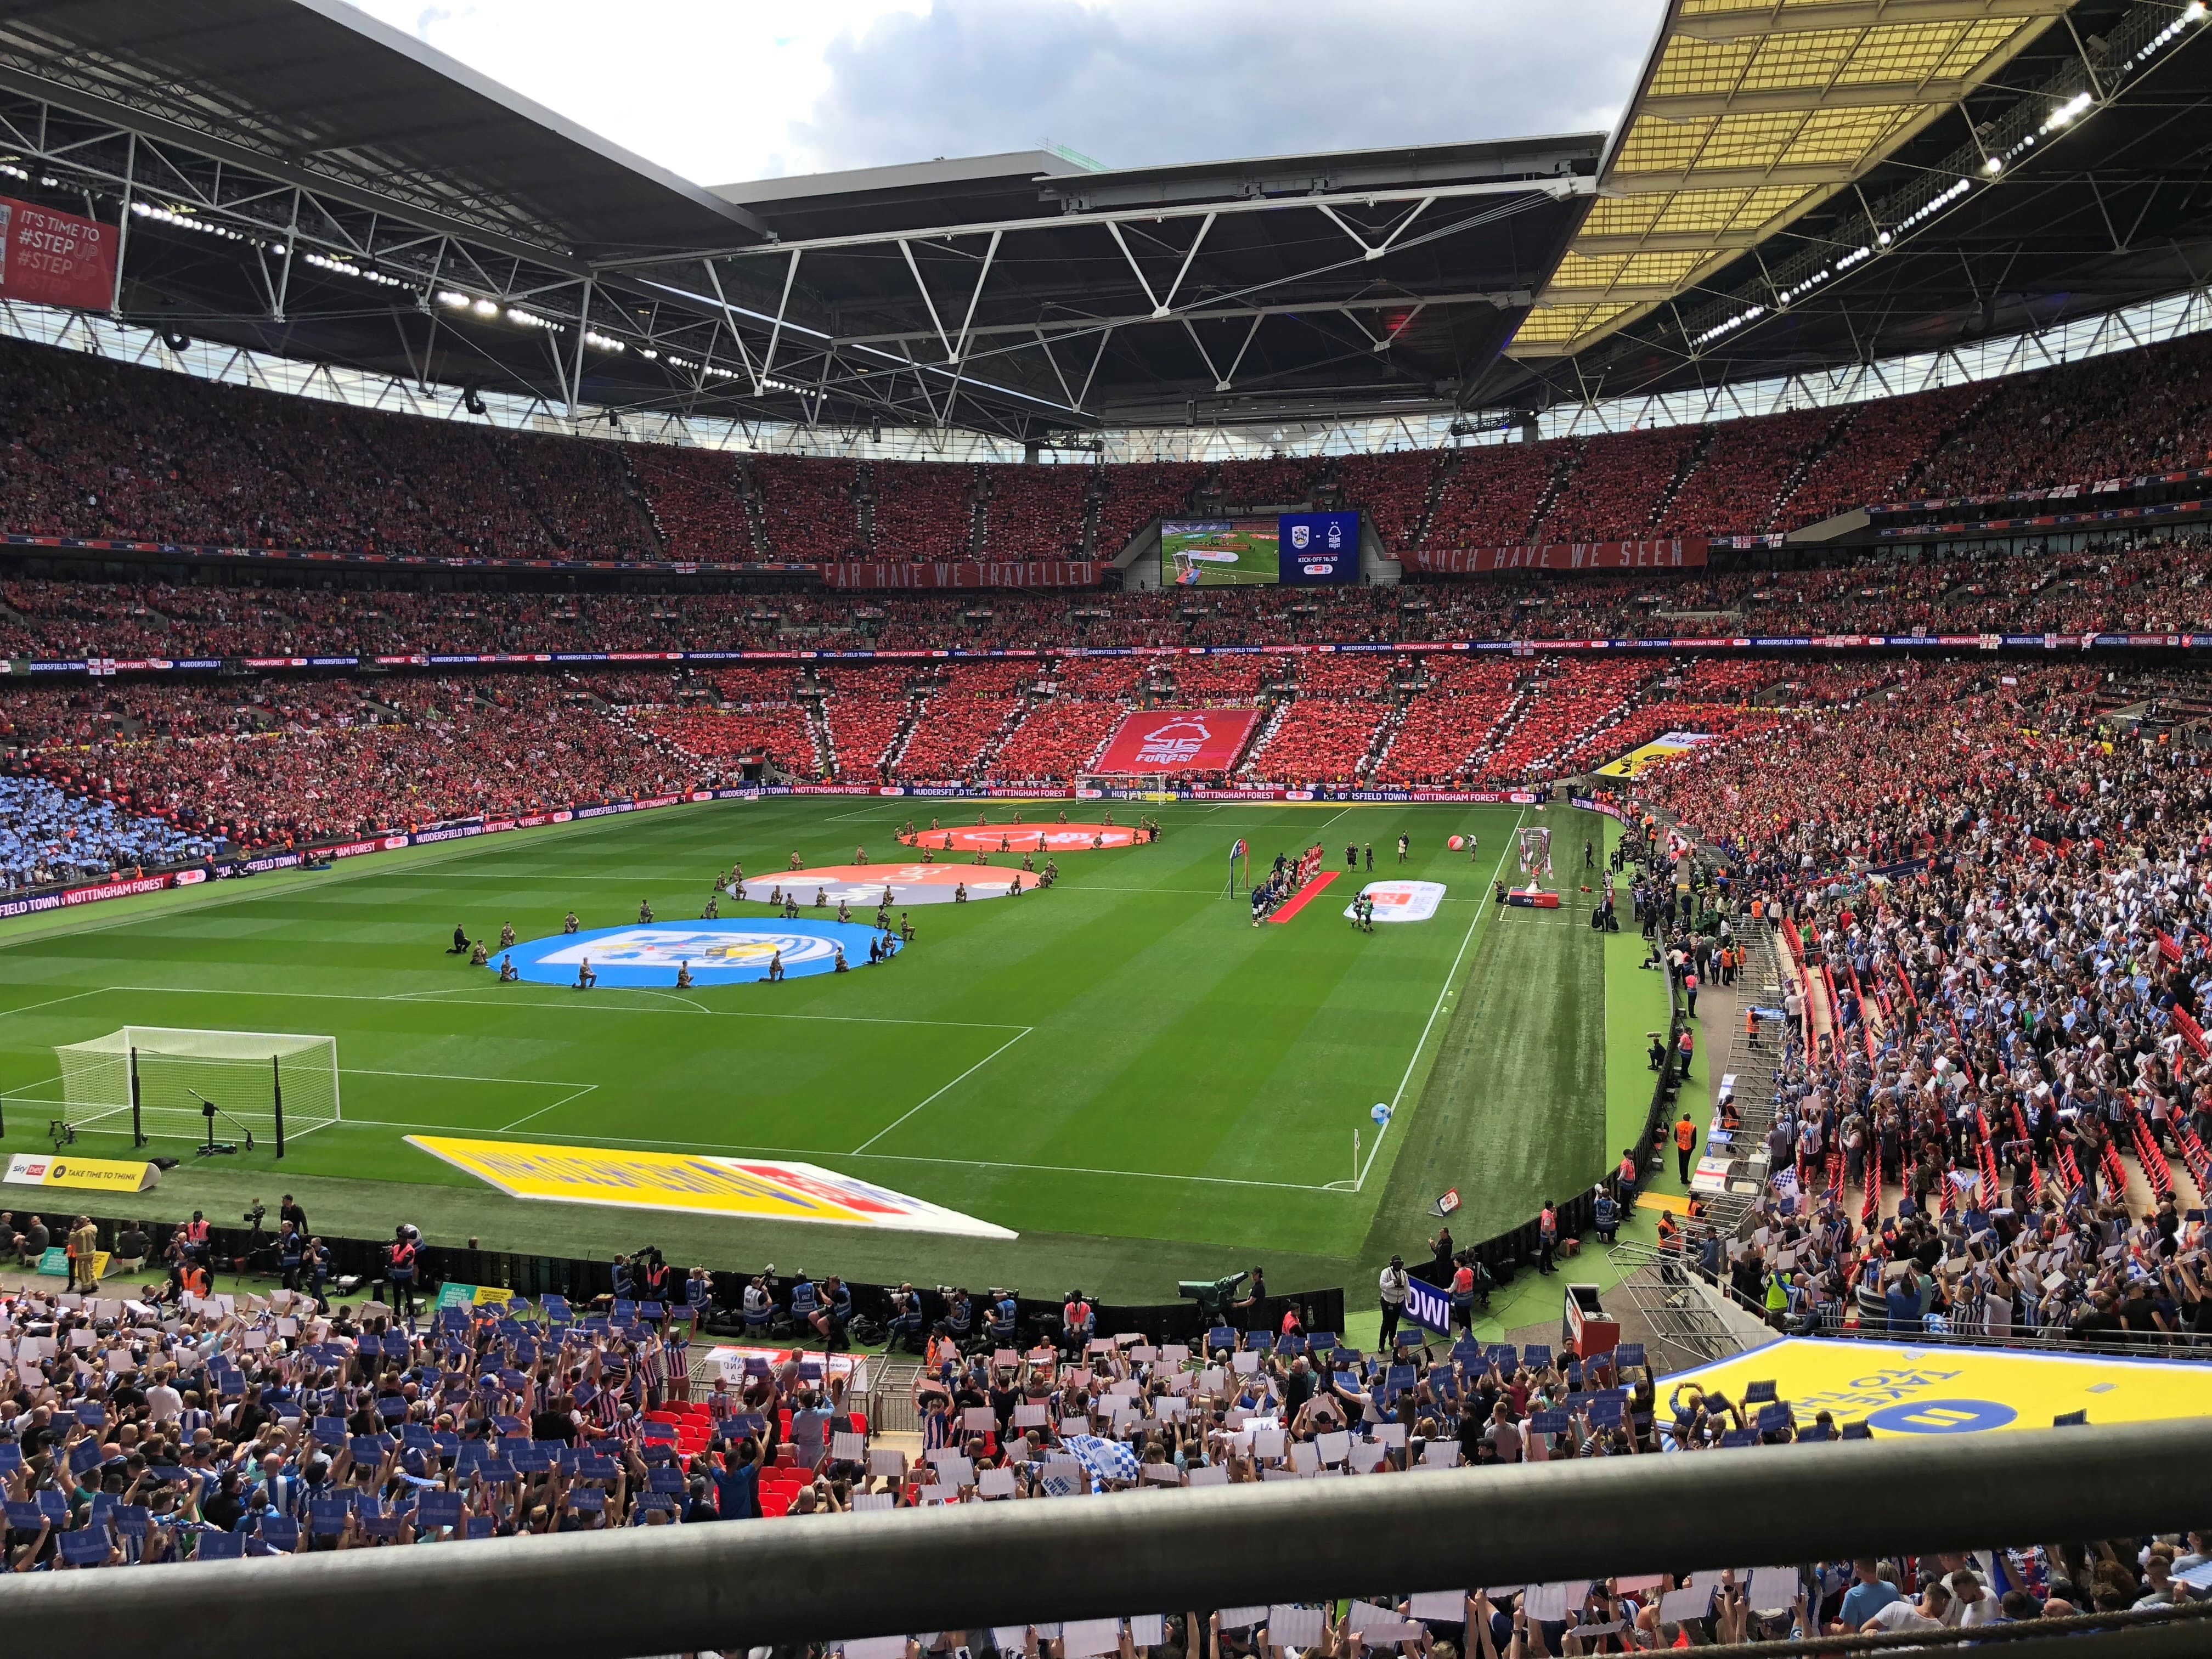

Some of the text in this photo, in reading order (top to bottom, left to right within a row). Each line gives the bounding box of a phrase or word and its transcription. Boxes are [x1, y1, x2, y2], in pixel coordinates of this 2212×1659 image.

[20, 210, 100, 241] IT'S TIME TO
[1418, 540, 1682, 572] MUCH HAVE WE SEEN
[825, 561, 1093, 588] FAR HAVE WE TRAVELLED
[720, 788, 765, 798] HUDDERSFIELD
[768, 786, 789, 794] TOWN
[795, 785, 843, 794] NOTTINGHAM
[845, 786, 871, 794] FOREST
[992, 788, 1039, 797] NOTTINGHAM
[1041, 789, 1066, 798] FOREST
[1195, 791, 1245, 799] NOTTINGHAM
[1414, 793, 1469, 802] NOTTINGHAM
[1470, 794, 1499, 802] FOREST
[579, 805, 617, 818] HUDDERSFIELD
[618, 803, 633, 812] TOWN
[636, 799, 669, 811] NOTTINGHAM
[416, 826, 462, 844] HUDDERSFIELD
[463, 825, 481, 834] TOWN
[524, 816, 545, 827] FOREST
[275, 855, 297, 867] TOWN
[351, 842, 375, 855] FOREST
[866, 865, 953, 882] bet
[29, 895, 59, 911] TOWN
[61, 897, 66, 906] v
[67, 884, 131, 905] NOTTINGHAM
[132, 877, 164, 894] FOREST
[13, 1164, 27, 1173] sky
[28, 1165, 44, 1174] bet
[68, 1169, 86, 1177] TAKE
[87, 1170, 103, 1178] TIME
[114, 1172, 136, 1181] THINK
[1848, 1368, 1918, 1388] TO
[1844, 1370, 1963, 1406] TAKE
[1087, 1440, 1104, 1451] FINAL
